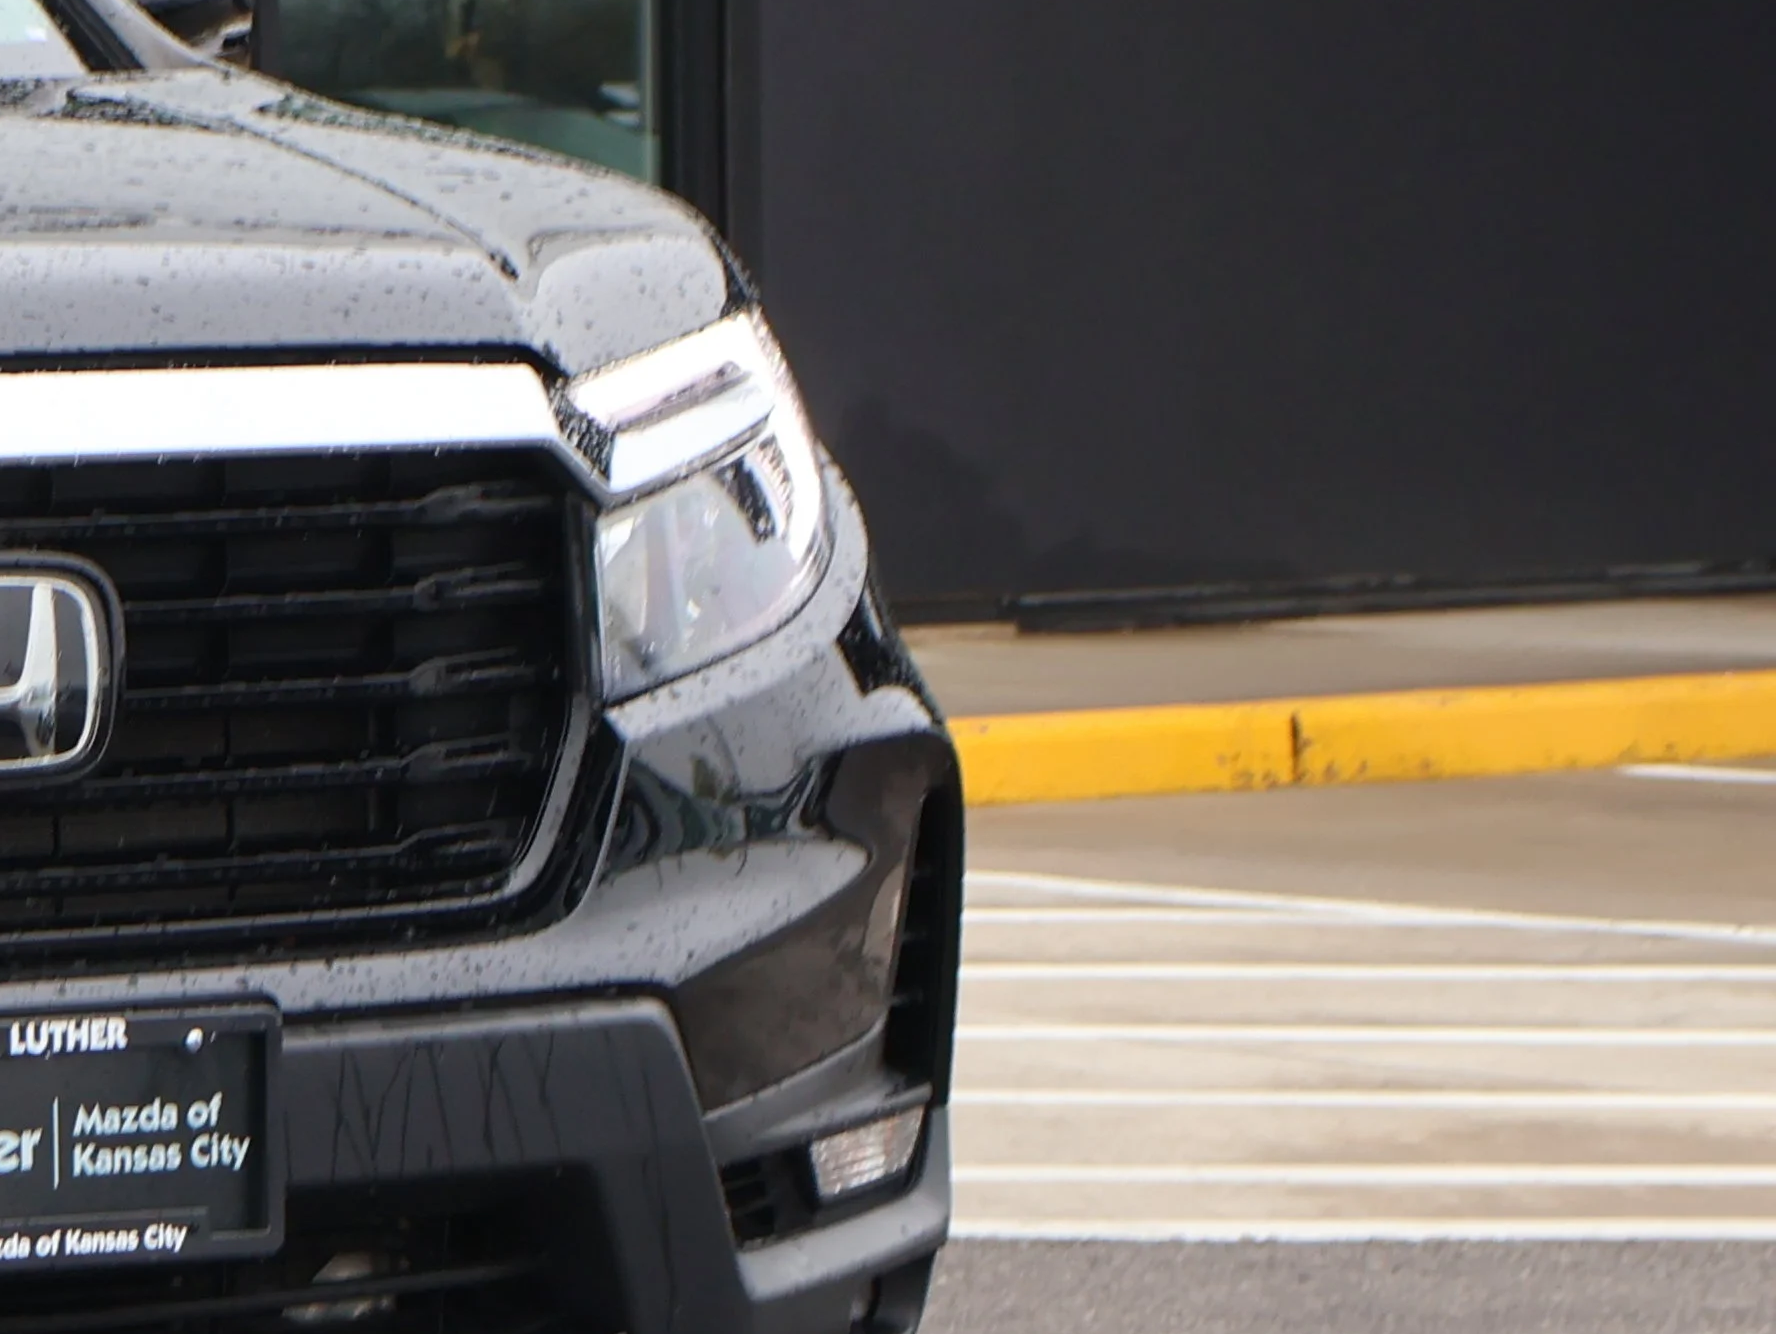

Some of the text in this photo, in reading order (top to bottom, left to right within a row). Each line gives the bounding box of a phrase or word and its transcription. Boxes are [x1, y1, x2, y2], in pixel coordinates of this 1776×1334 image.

[10, 1017, 128, 1056] LUTHER
[73, 1090, 223, 1137] Mazda of
[73, 1131, 251, 1177] Kansas City
[35, 1229, 61, 1257] of
[65, 1227, 140, 1255] Kansas
[144, 1222, 188, 1253] City
